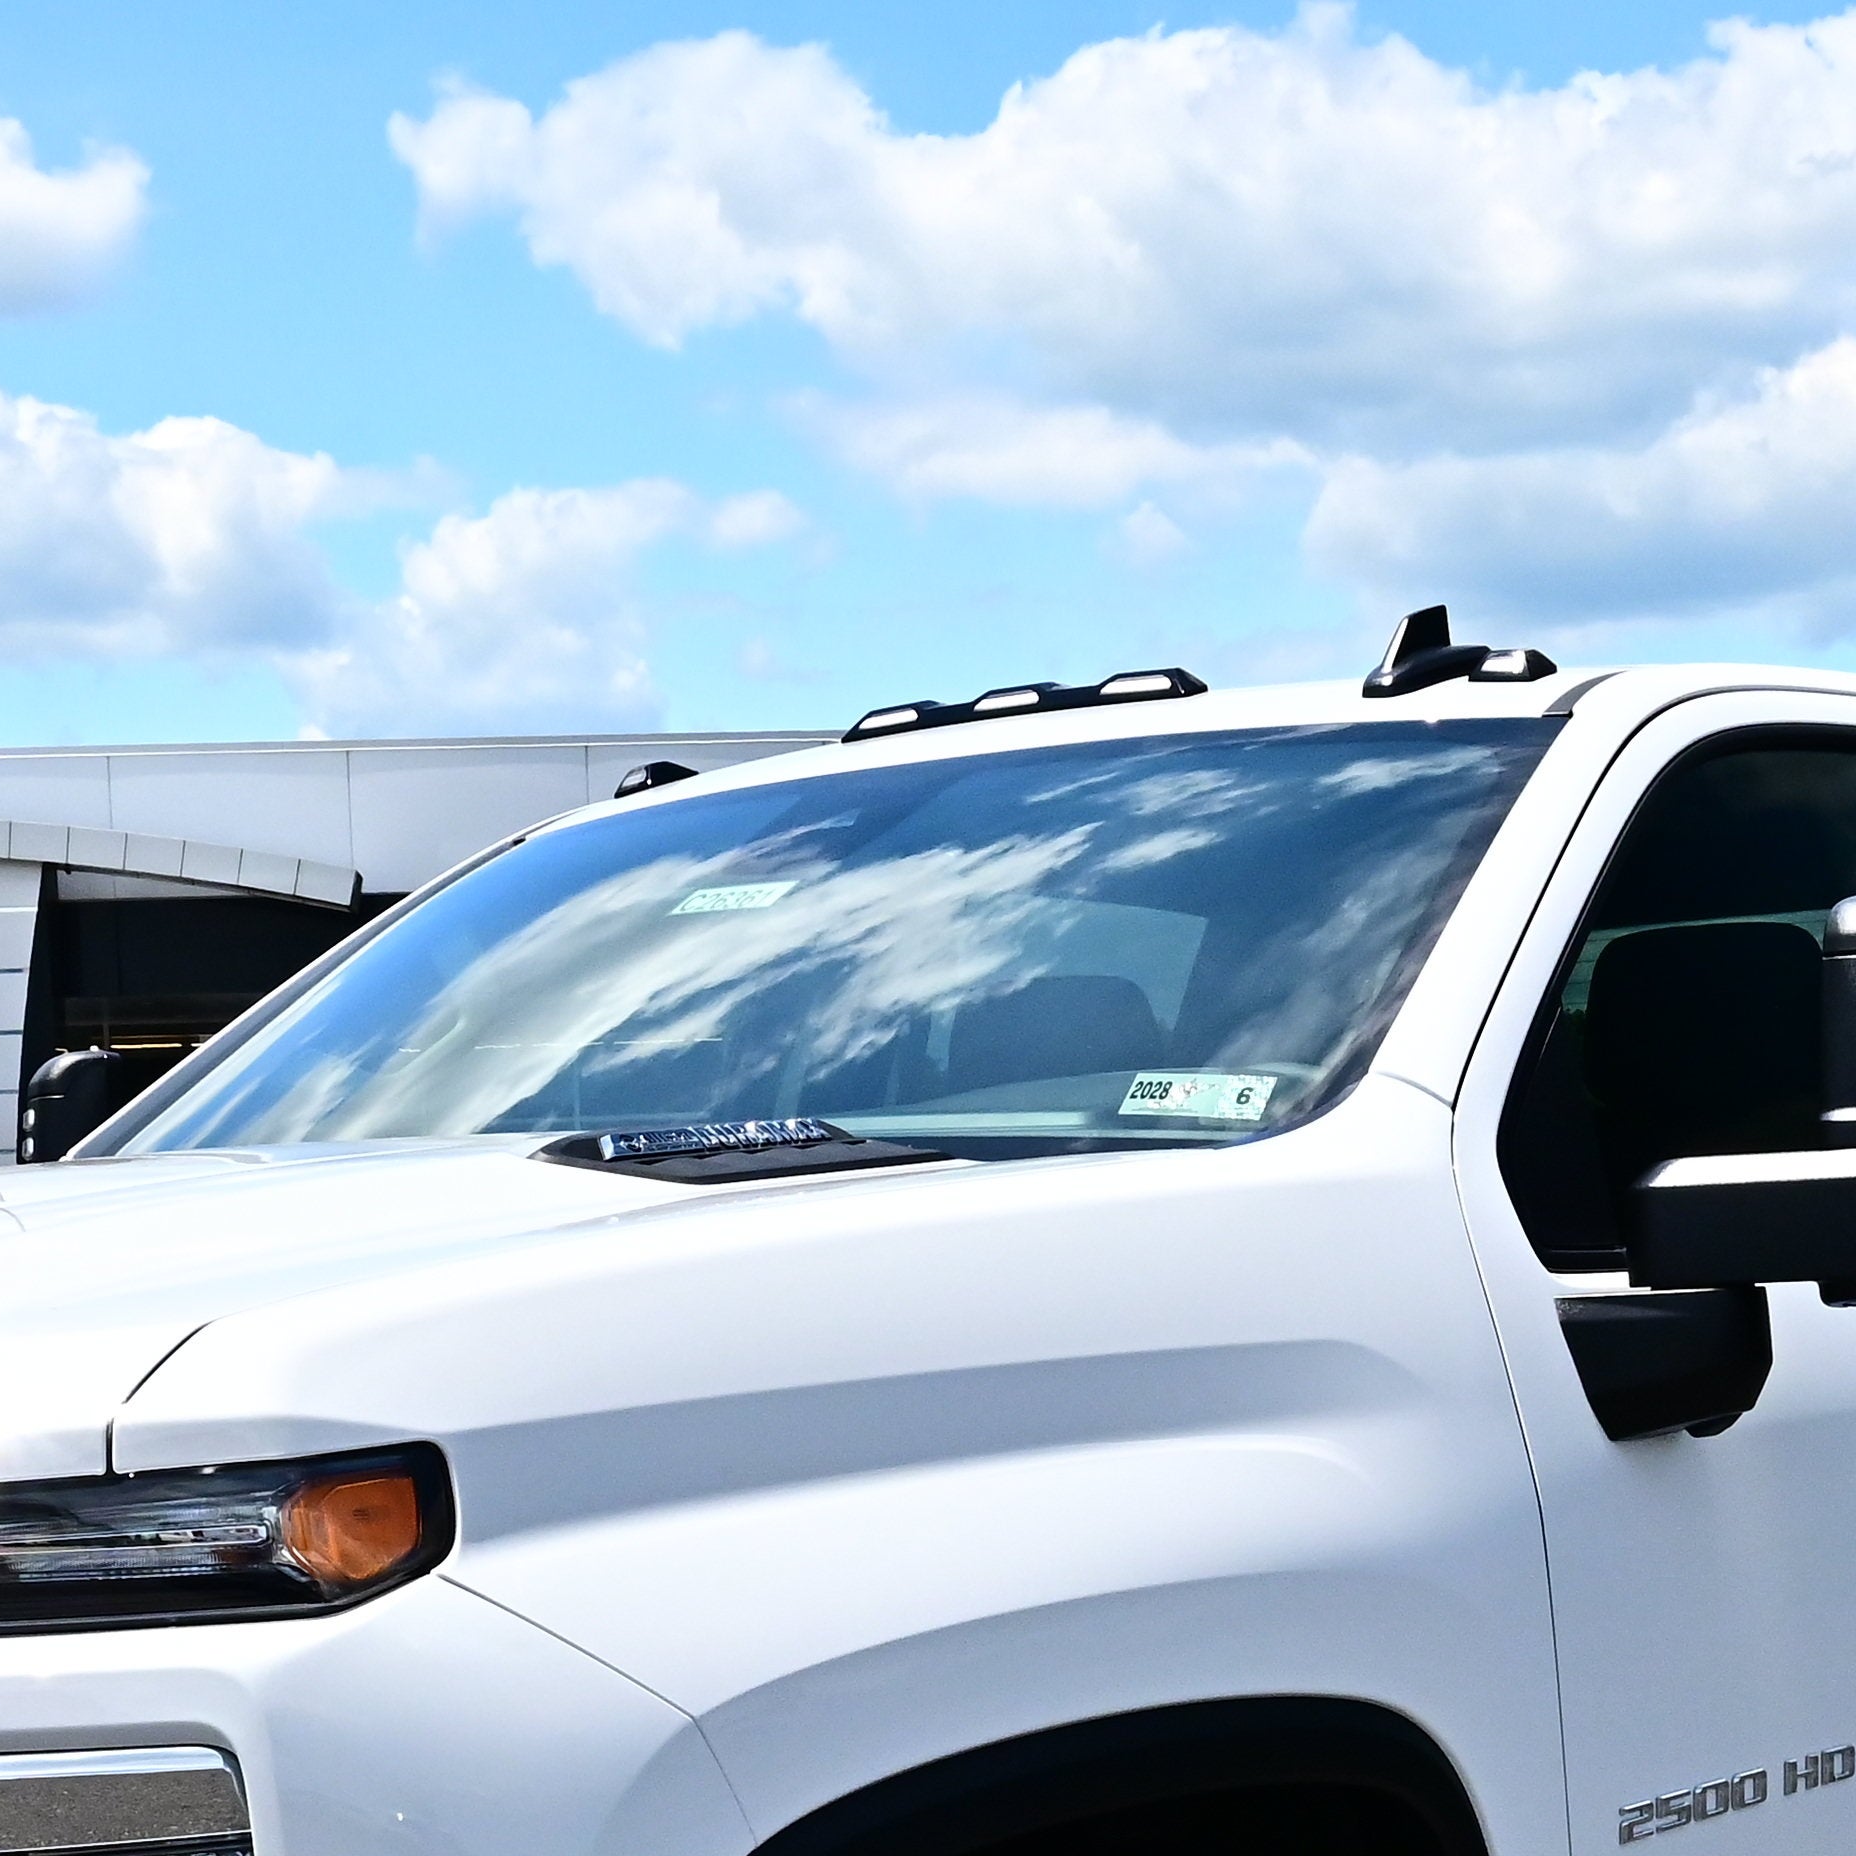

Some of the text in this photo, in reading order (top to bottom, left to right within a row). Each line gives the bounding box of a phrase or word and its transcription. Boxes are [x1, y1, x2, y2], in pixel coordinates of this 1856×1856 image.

[1129, 1081, 1254, 1105] 2028 6
[1619, 1744, 1856, 1845] 2500 HD
